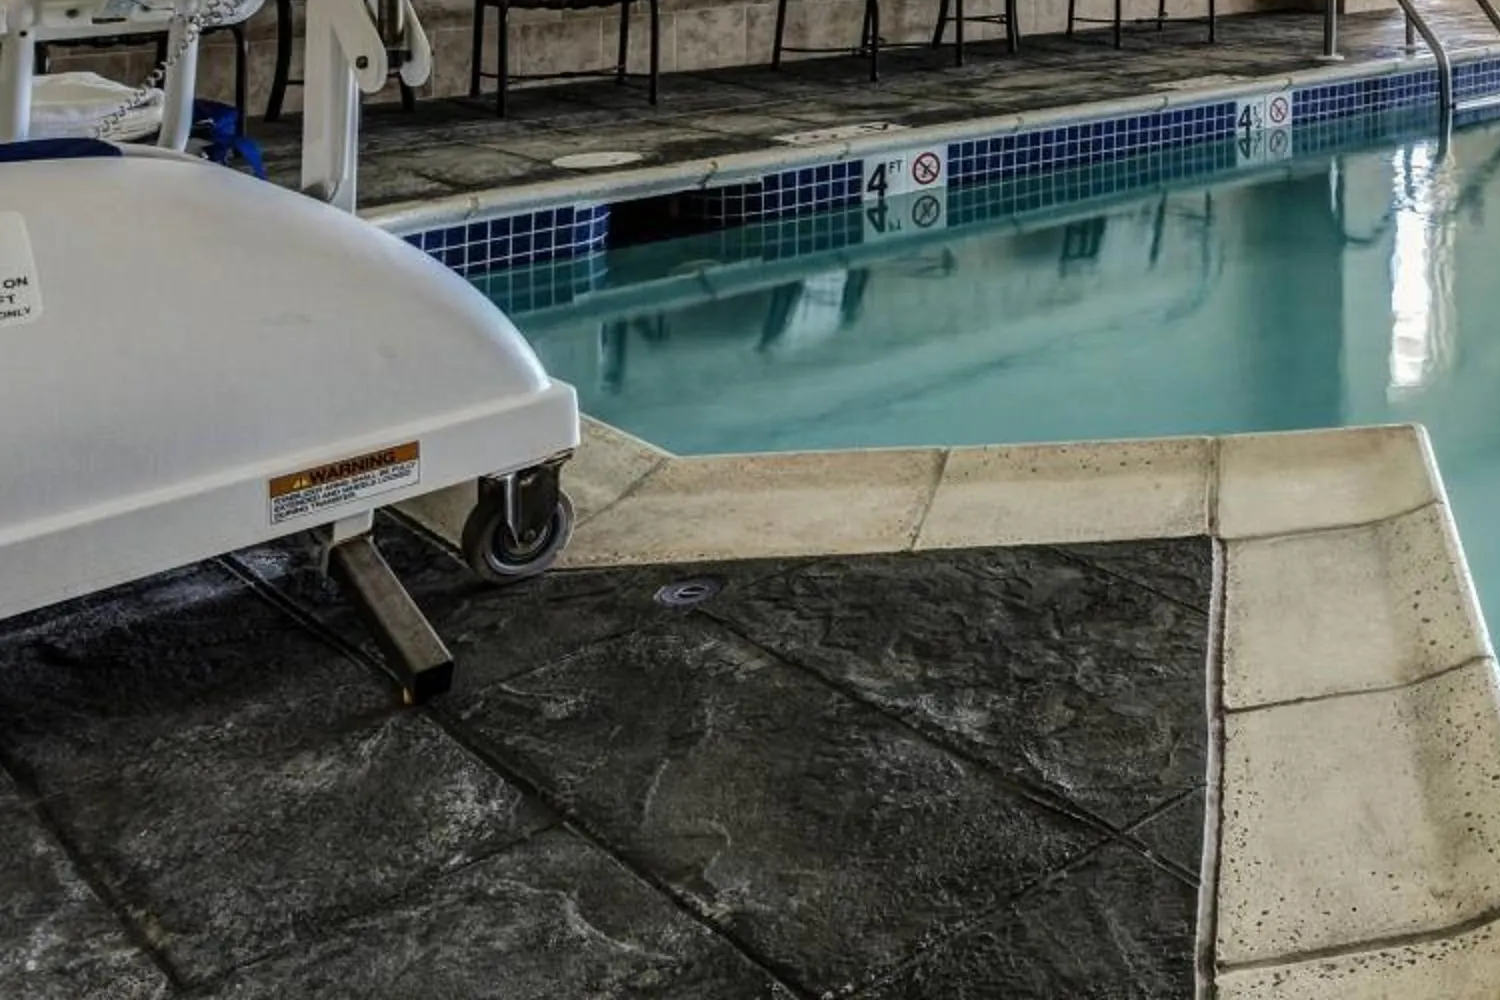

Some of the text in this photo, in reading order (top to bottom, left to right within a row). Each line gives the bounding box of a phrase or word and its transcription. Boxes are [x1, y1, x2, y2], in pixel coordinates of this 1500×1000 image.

[867, 158, 903, 198] 4 FT
[4, 276, 28, 288] ON
[310, 451, 395, 483] WARNING
